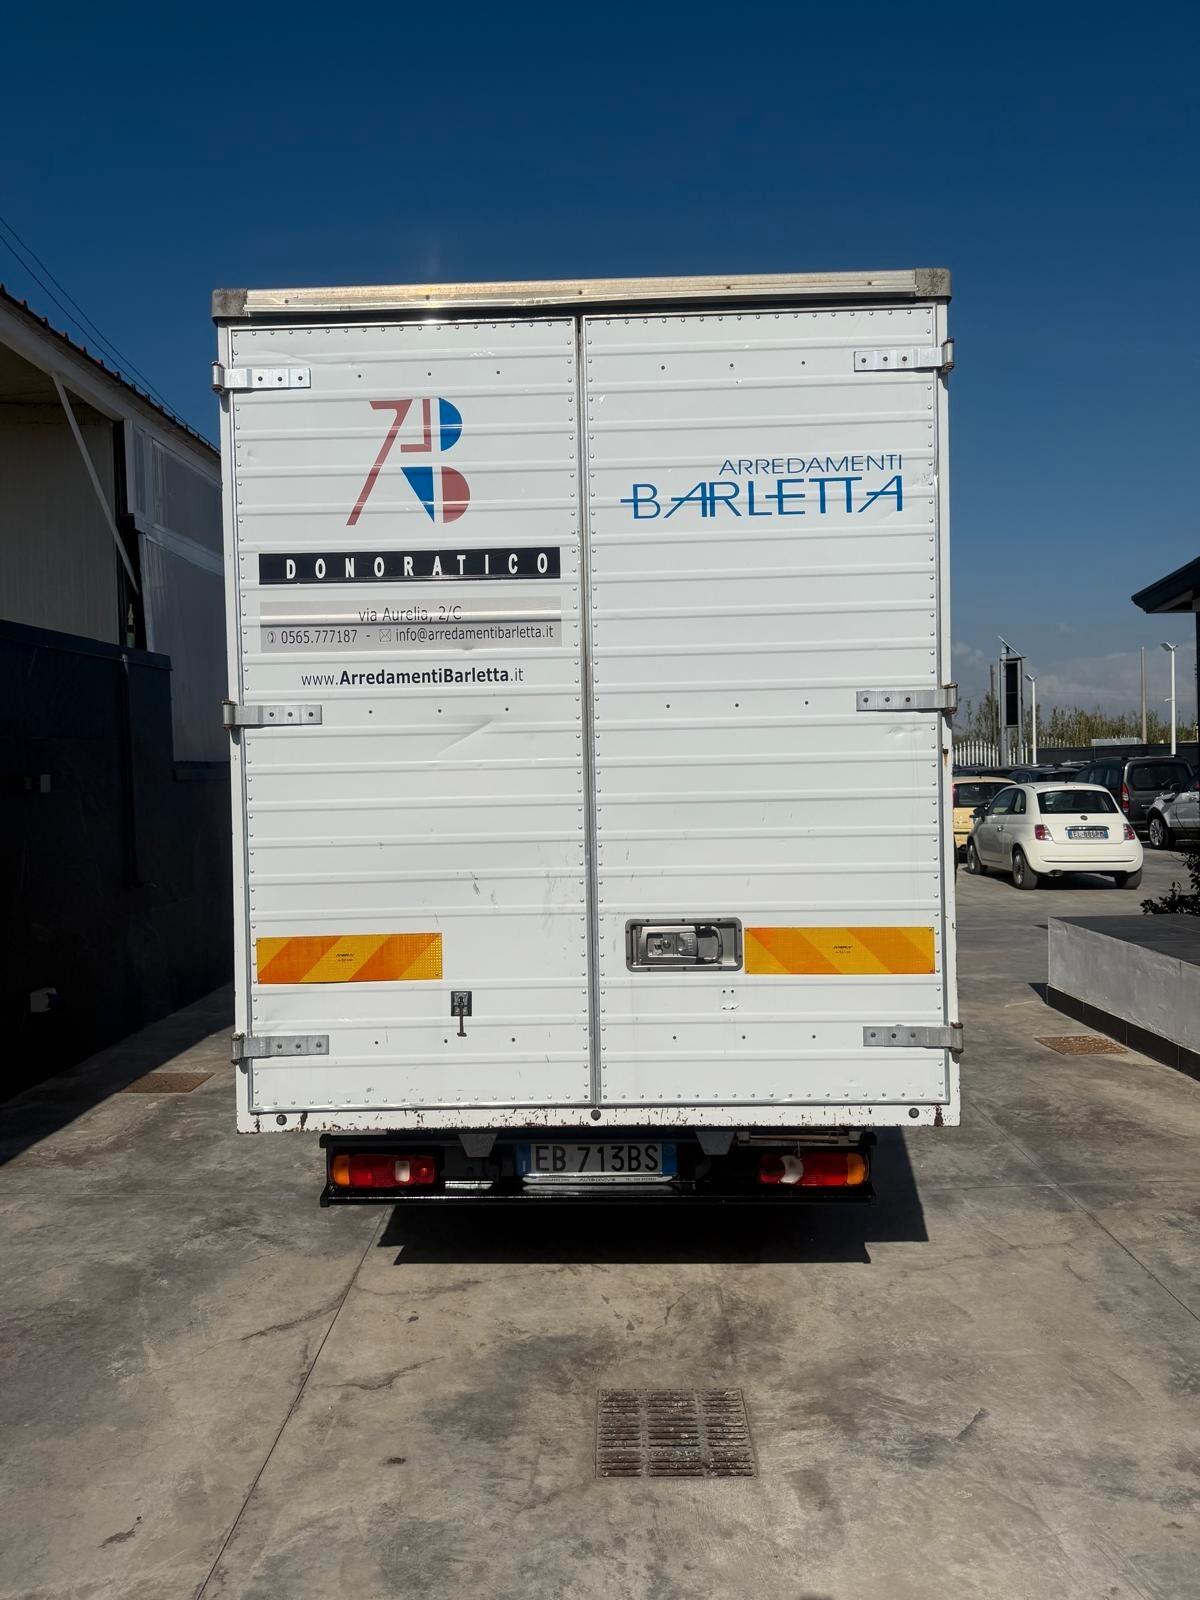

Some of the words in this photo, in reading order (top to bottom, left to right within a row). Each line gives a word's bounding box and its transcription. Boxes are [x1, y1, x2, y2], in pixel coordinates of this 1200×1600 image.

[719, 454, 902, 475] ARREDAMENTI
[620, 475, 903, 519] BARLETTA
[286, 553, 548, 579] DONORATICO
[358, 607, 377, 622] via
[382, 605, 433, 623] Aurelia,
[438, 605, 462, 622] 2/C
[281, 629, 357, 644] 0565.777187
[396, 625, 554, 642] info@arredamentibarletta.it
[301, 668, 524, 686] www.ArredamentiBarletta.it
[535, 1145, 567, 1172] EB
[577, 1145, 659, 1173] 713BS
